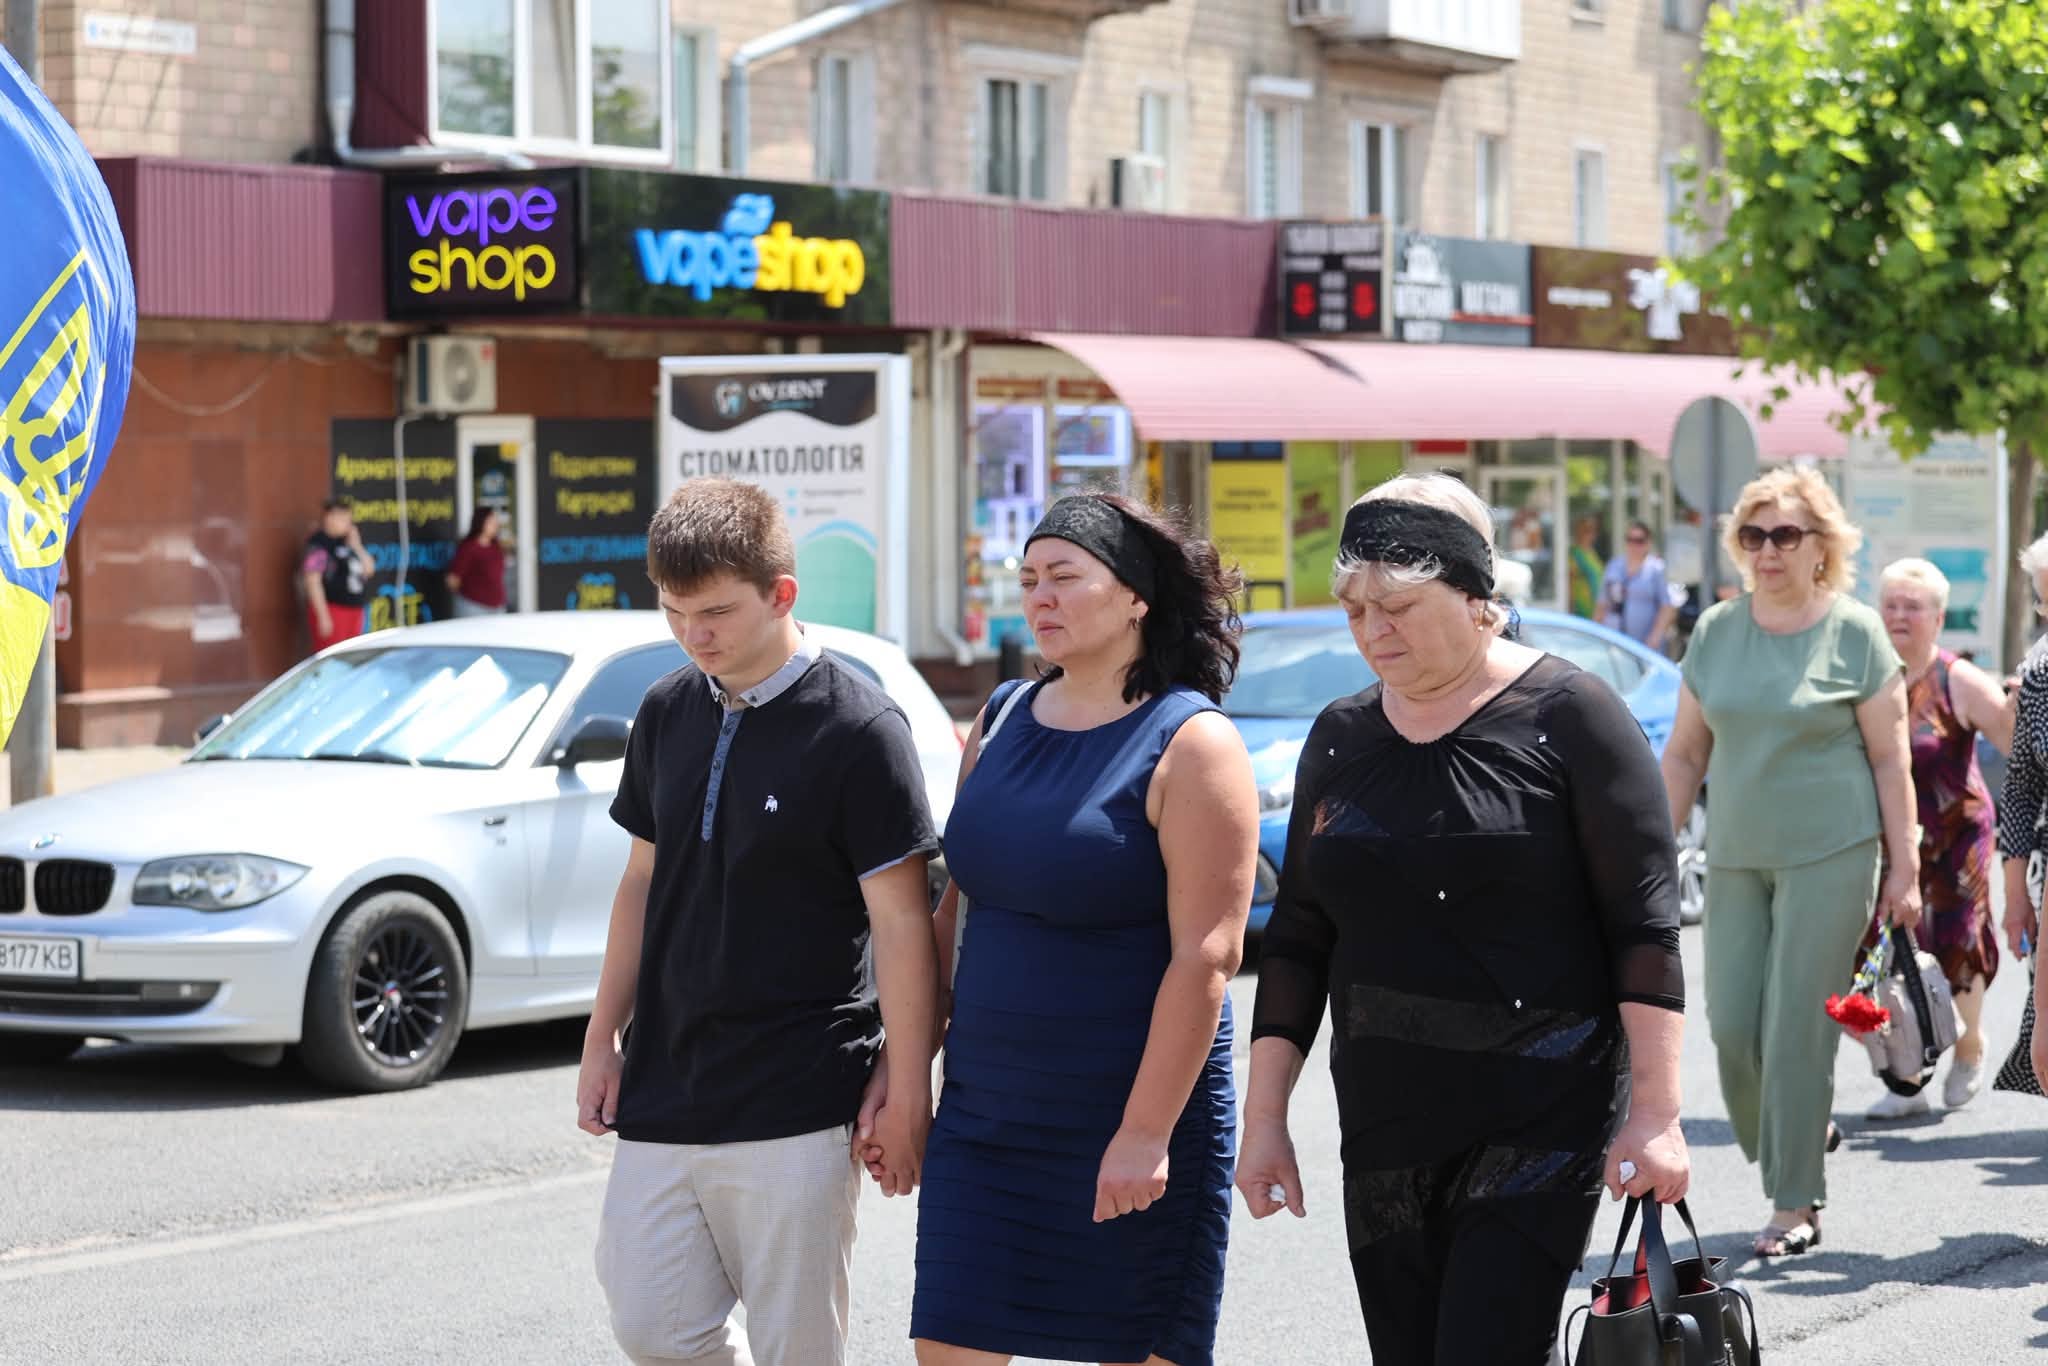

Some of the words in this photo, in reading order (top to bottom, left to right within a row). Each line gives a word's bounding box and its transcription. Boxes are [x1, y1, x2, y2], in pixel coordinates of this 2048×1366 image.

[406, 186, 558, 246] vape
[409, 238, 556, 302] shop
[679, 445, 865, 478] СТОМАТОЛОГІЯ
